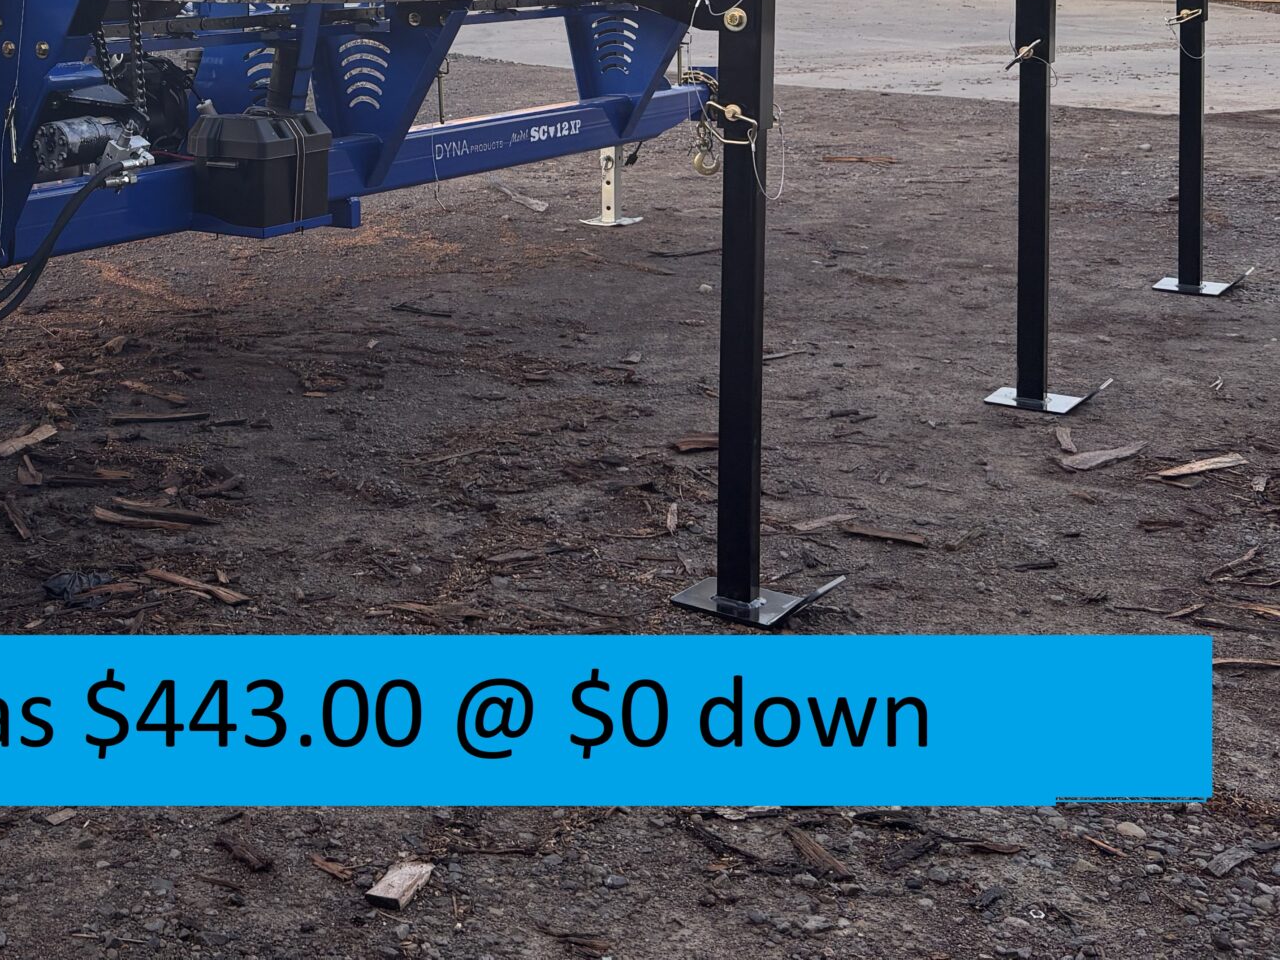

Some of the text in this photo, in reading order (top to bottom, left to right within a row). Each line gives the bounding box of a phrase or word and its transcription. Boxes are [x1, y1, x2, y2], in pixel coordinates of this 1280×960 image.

[435, 140, 470, 160] DYNA
[470, 140, 504, 153] PRODUCTS
[570, 119, 582, 135] XP
